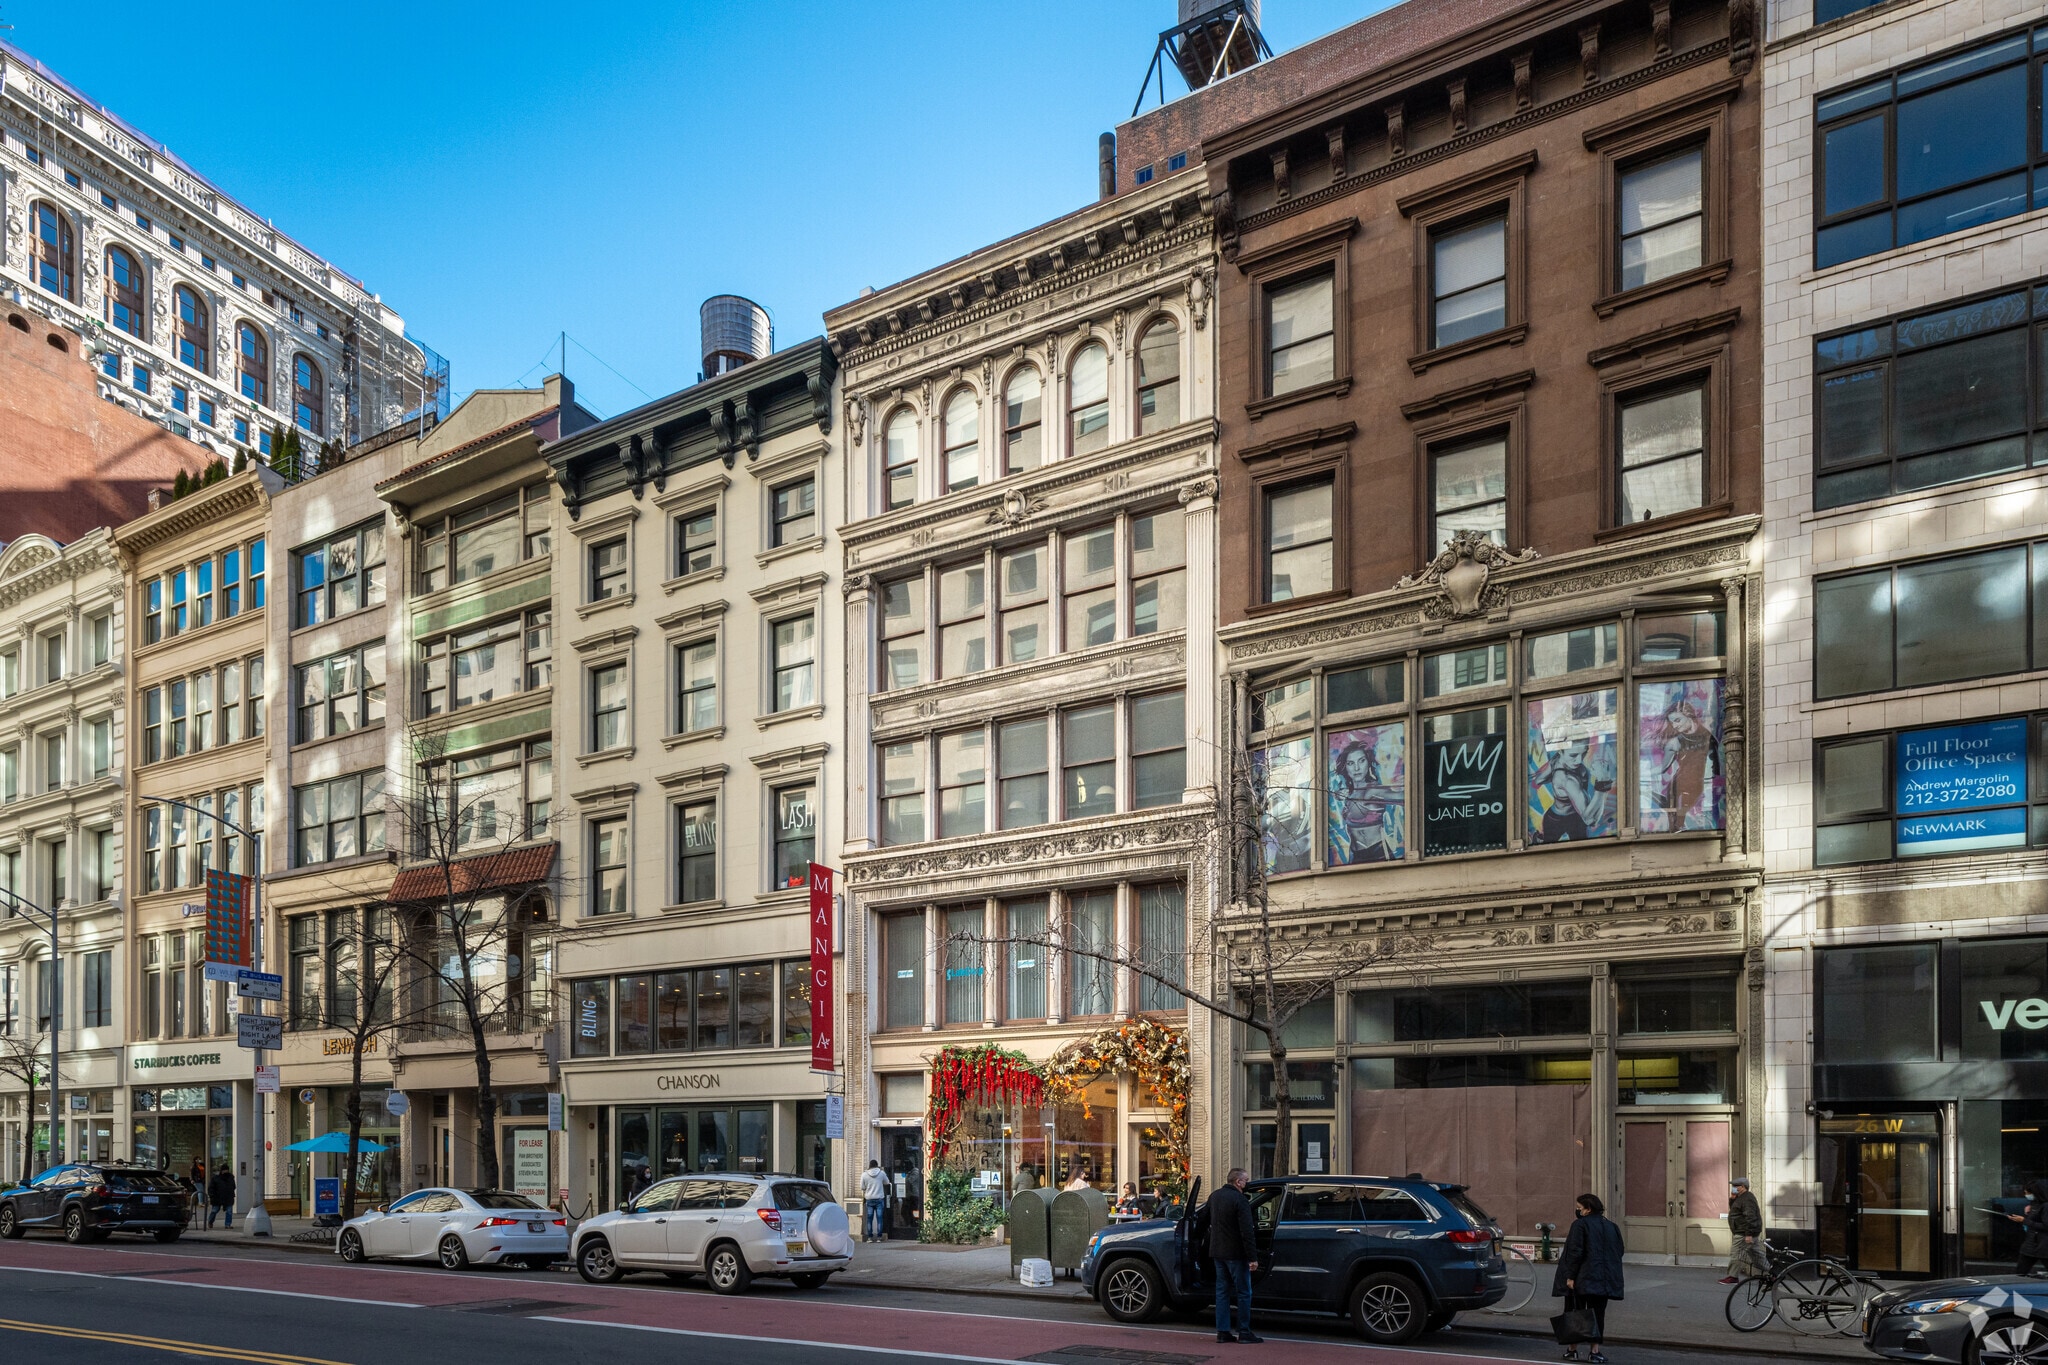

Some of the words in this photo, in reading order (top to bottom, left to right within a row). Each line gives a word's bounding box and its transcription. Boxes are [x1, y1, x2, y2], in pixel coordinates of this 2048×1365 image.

[1905, 740, 1938, 757] Full
[1944, 738, 1992, 753] Floor
[1905, 756, 1958, 772] Office
[1963, 751, 2016, 770] Space
[1904, 780, 1951, 792] Andrew
[1954, 773, 2010, 786] Margolin
[1904, 783, 2016, 806] 212-372-2080
[1428, 804, 1475, 821] JANE
[1479, 801, 1504, 816] DO
[1903, 819, 1987, 836] NEWMARK
[813, 874, 830, 1050] MANGIA
[581, 1000, 597, 1038] BLING
[134, 1055, 186, 1070] STARBUCKS
[186, 1052, 221, 1067] COFFEE
[657, 1073, 720, 1091] CHANSON
[1854, 1120, 1879, 1133] 26
[1884, 1119, 1904, 1133] W
[518, 1139, 529, 1148] FOR
[529, 1139, 543, 1148] LEASE
[992, 1173, 1000, 1181] A
